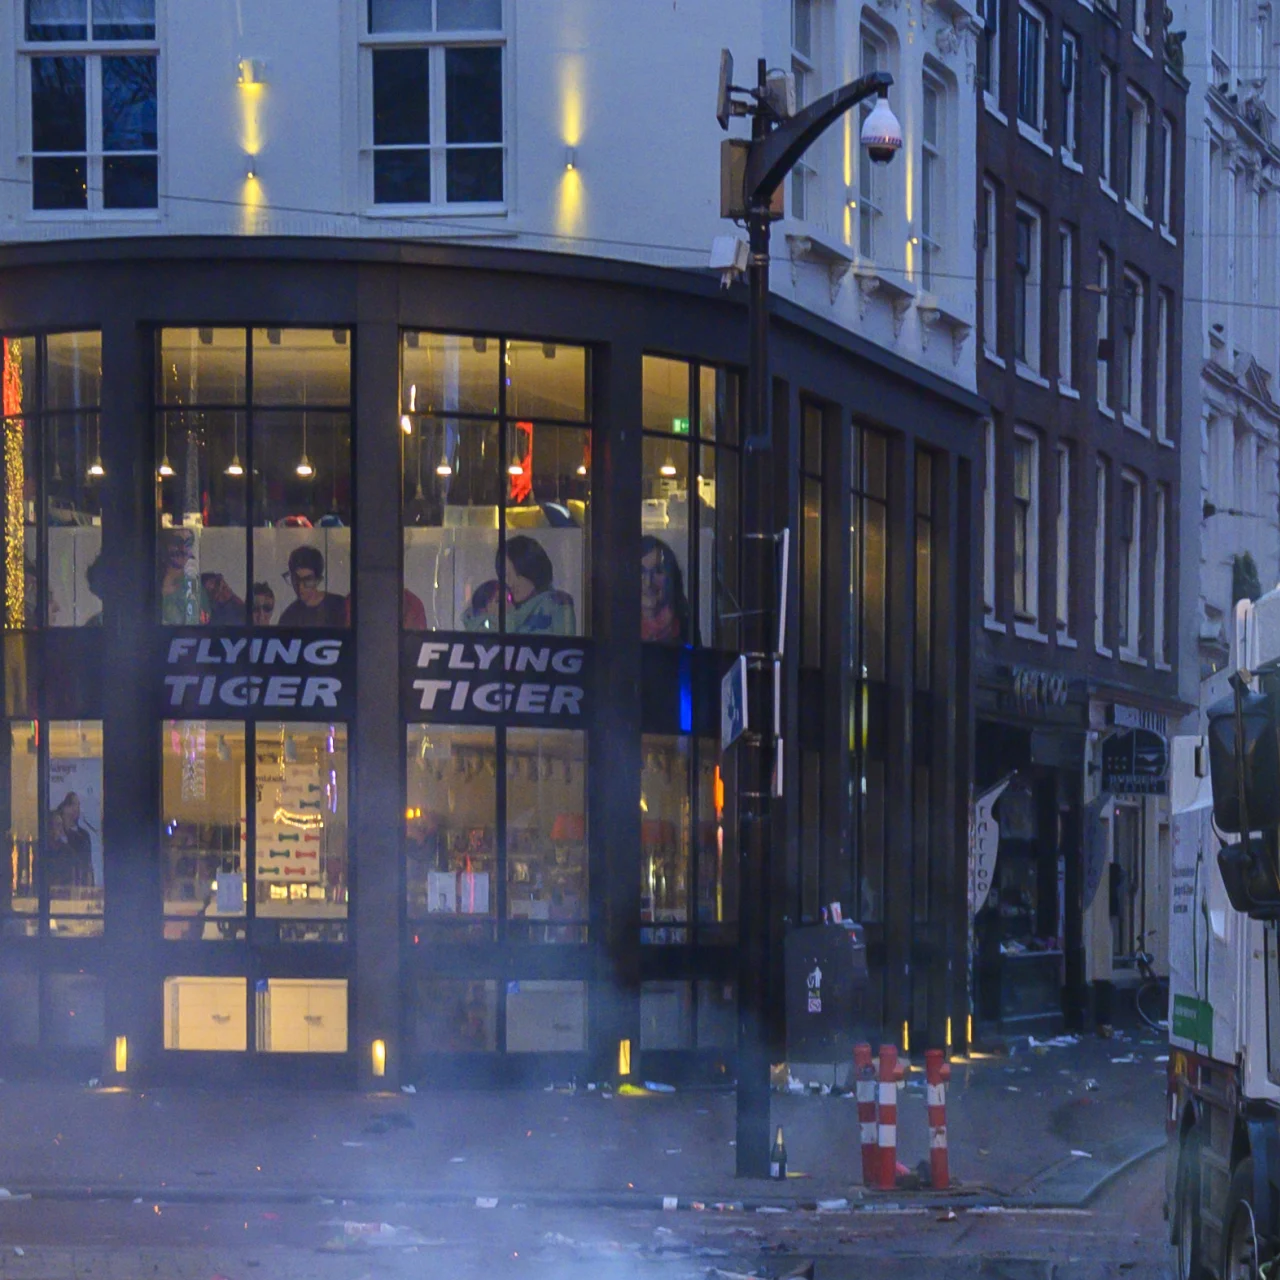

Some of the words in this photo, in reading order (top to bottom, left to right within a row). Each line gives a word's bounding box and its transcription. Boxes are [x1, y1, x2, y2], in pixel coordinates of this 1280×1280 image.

[167, 637, 342, 665] FLYING
[416, 642, 584, 673] FLYING
[164, 675, 342, 707] TIGER
[413, 679, 584, 714] TIGER
